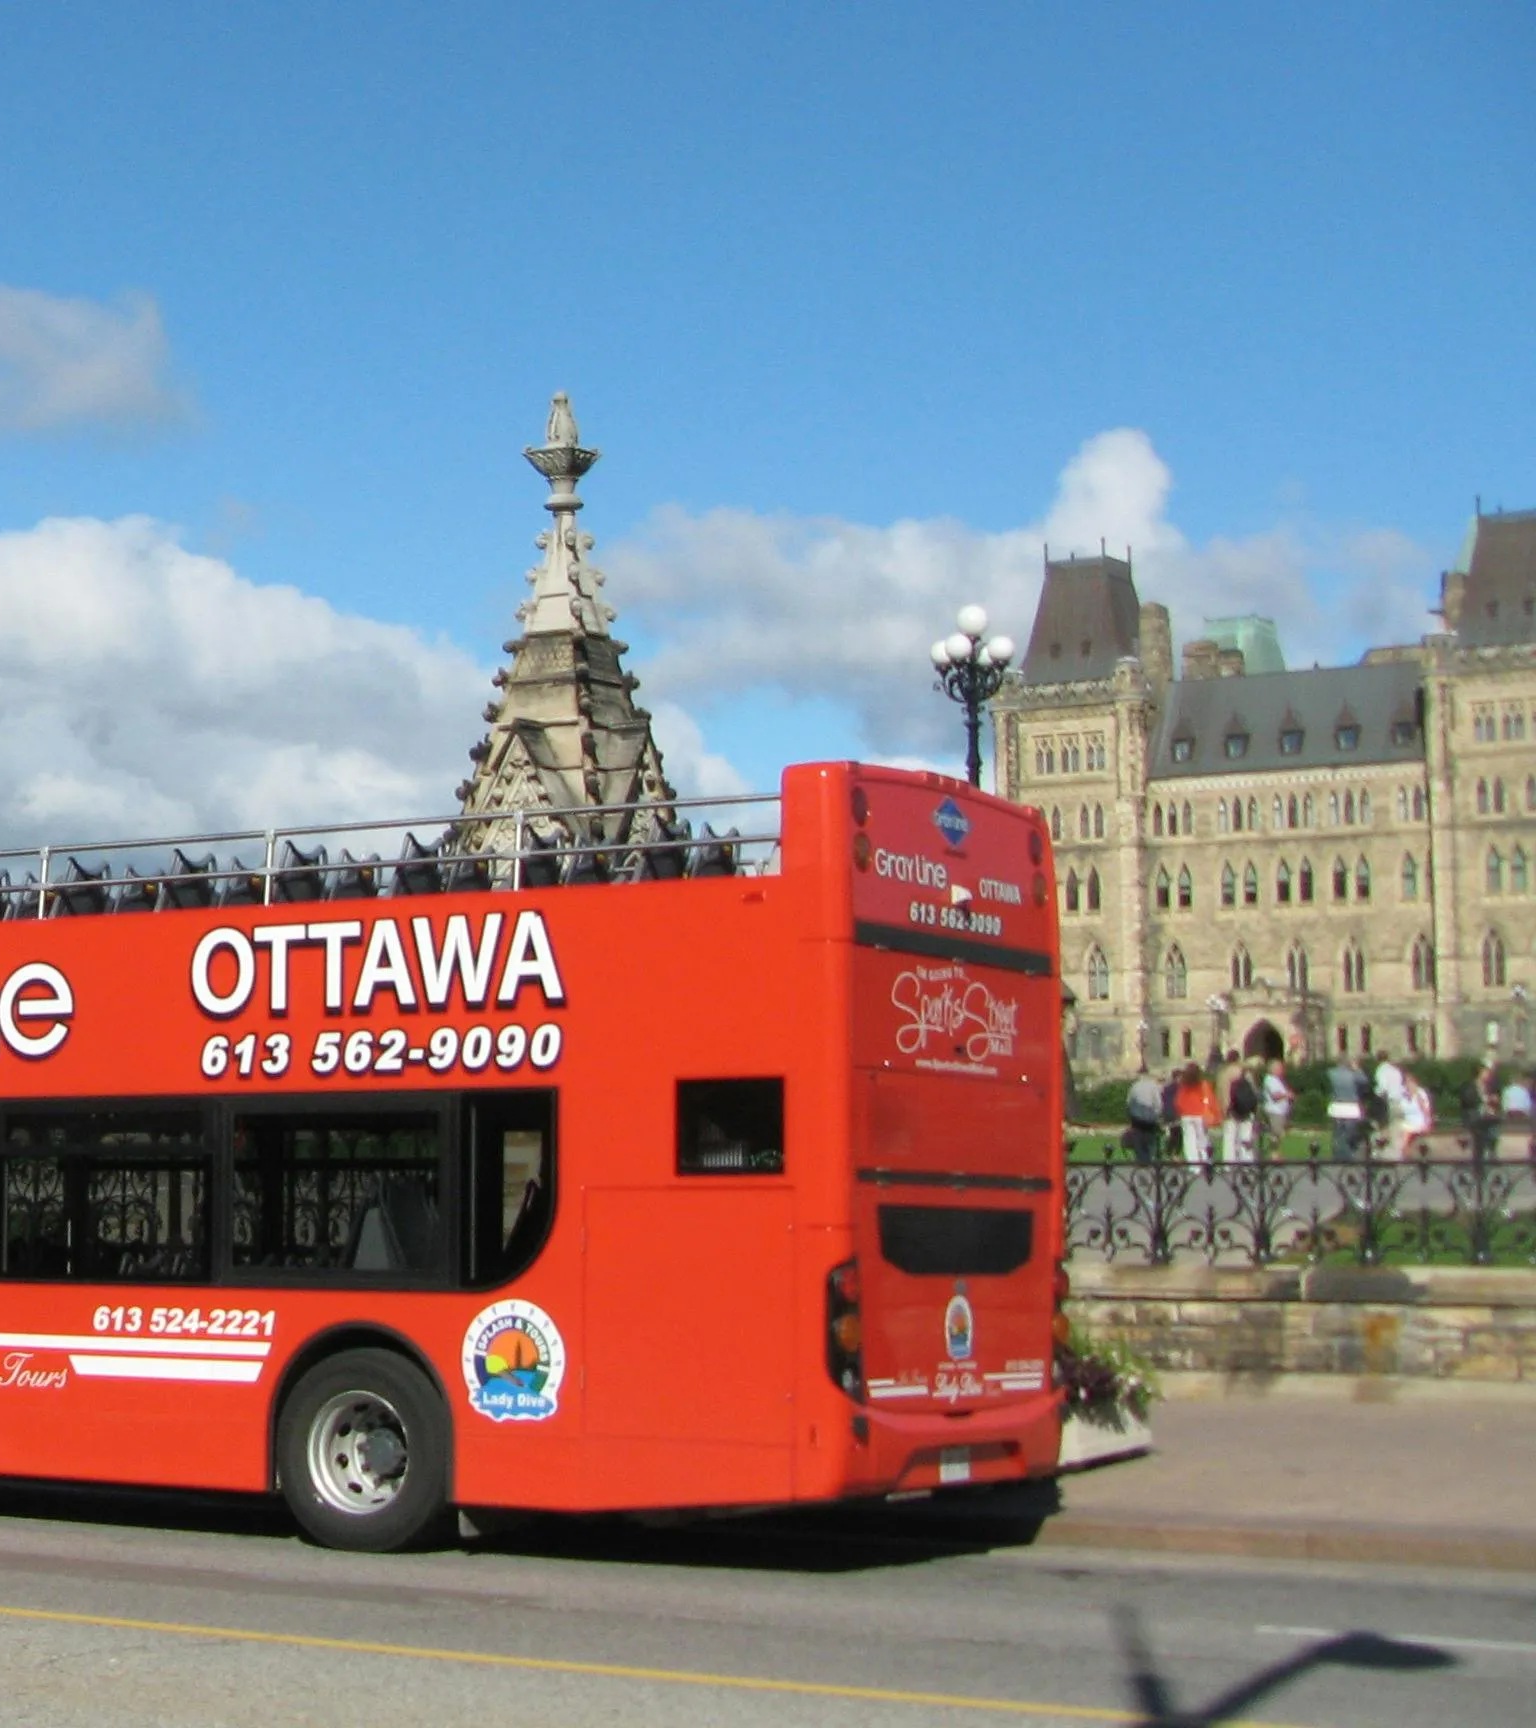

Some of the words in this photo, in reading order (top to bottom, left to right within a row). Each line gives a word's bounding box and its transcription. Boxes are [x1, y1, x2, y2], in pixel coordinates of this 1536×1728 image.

[875, 848, 914, 883] Gray
[914, 853, 948, 889] Line
[979, 877, 1022, 905] OTTAWA
[909, 901, 936, 925] 613
[191, 911, 565, 1021] OTTAWA
[201, 1033, 292, 1080] 613
[311, 1023, 563, 1076] 562-9090
[93, 1306, 143, 1332] 613
[149, 1307, 276, 1336] 524-2221
[482, 1391, 514, 1409] Lady
[517, 1392, 546, 1408] Dive
